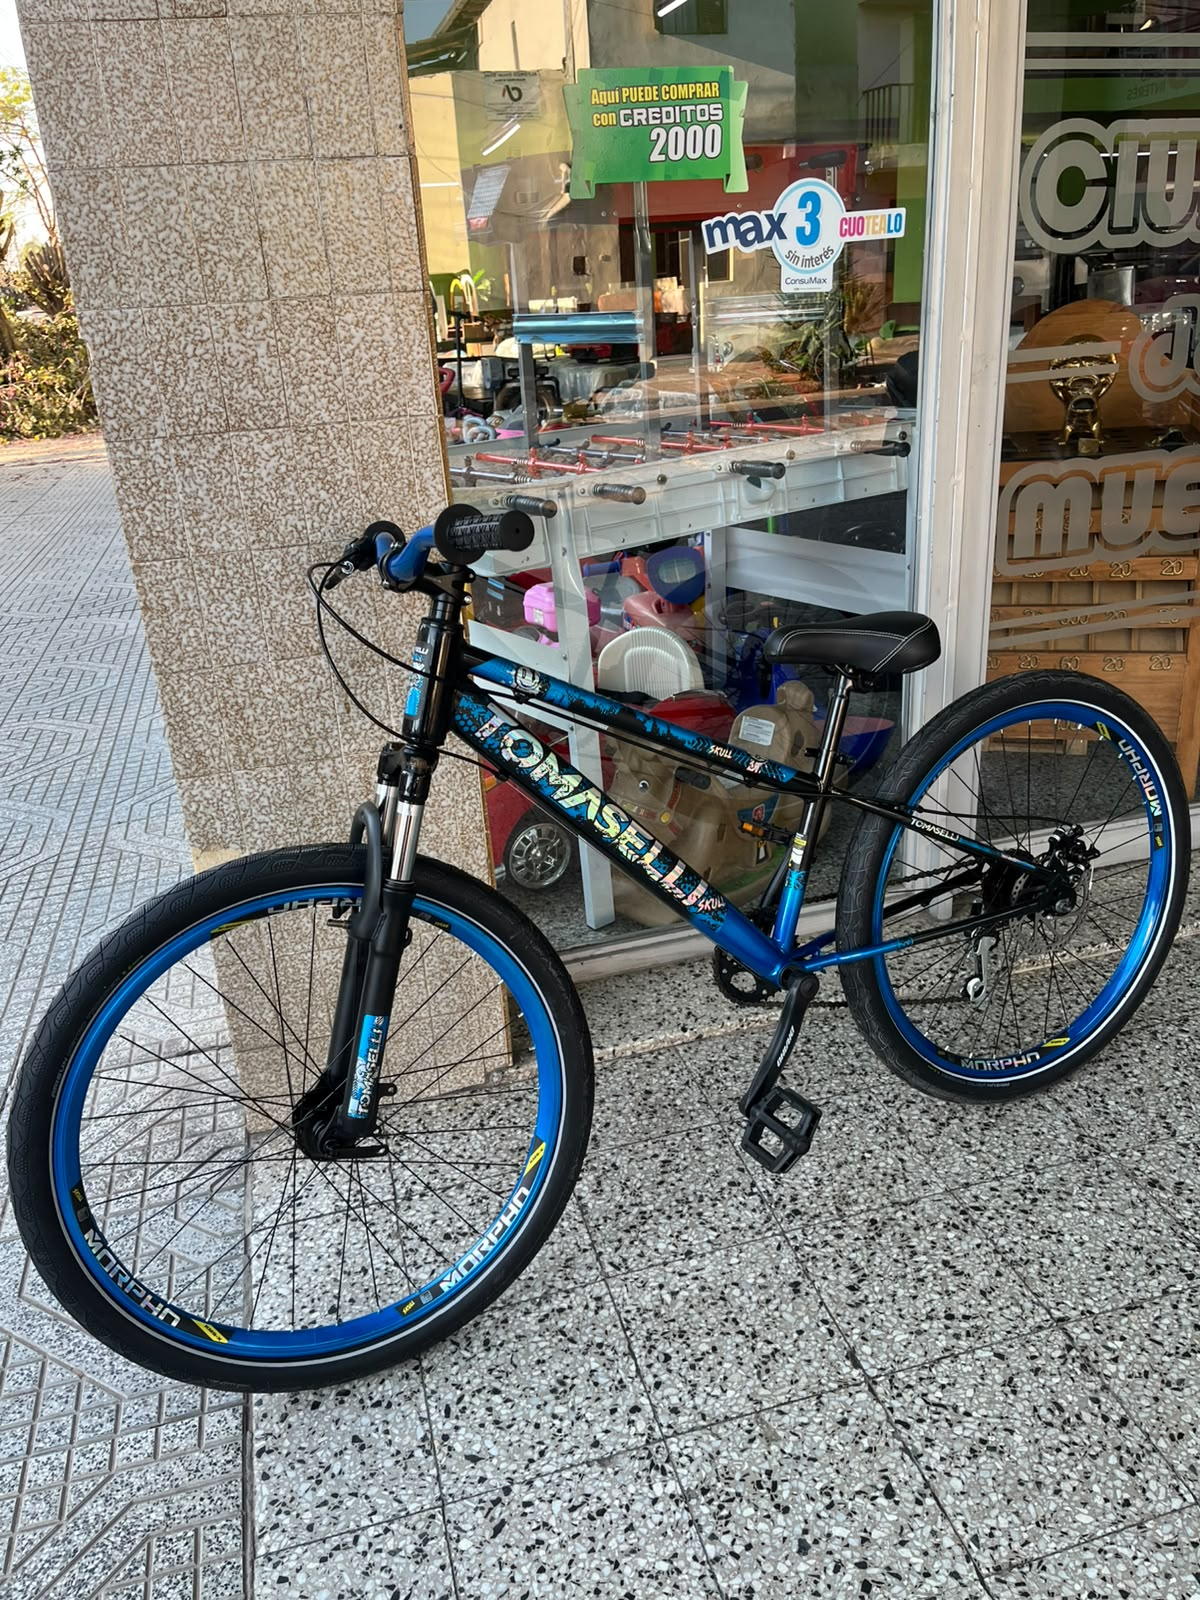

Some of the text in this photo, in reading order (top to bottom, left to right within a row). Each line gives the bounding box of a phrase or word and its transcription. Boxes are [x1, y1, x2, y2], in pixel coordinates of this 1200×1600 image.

[591, 82, 720, 106] Aquí PUEDE COMPRAR
[592, 103, 723, 127] con CREDITOS
[649, 123, 722, 162] 2000
[705, 191, 902, 248] max 3 CUOTEALO
[784, 245, 835, 268] sin interés
[785, 277, 827, 285] ConsuMax
[1138, 304, 1198, 393] d
[1160, 559, 1185, 576] 20
[1018, 655, 1041, 669] 20
[1103, 657, 1126, 671] 20
[1150, 656, 1173, 670] 20
[708, 745, 732, 759] SKULL
[475, 702, 709, 906] TOMASELLI
[910, 817, 960, 842] TOMASELLI
[697, 895, 726, 912] SKULL
[358, 1027, 383, 1116] TOMASELLI
